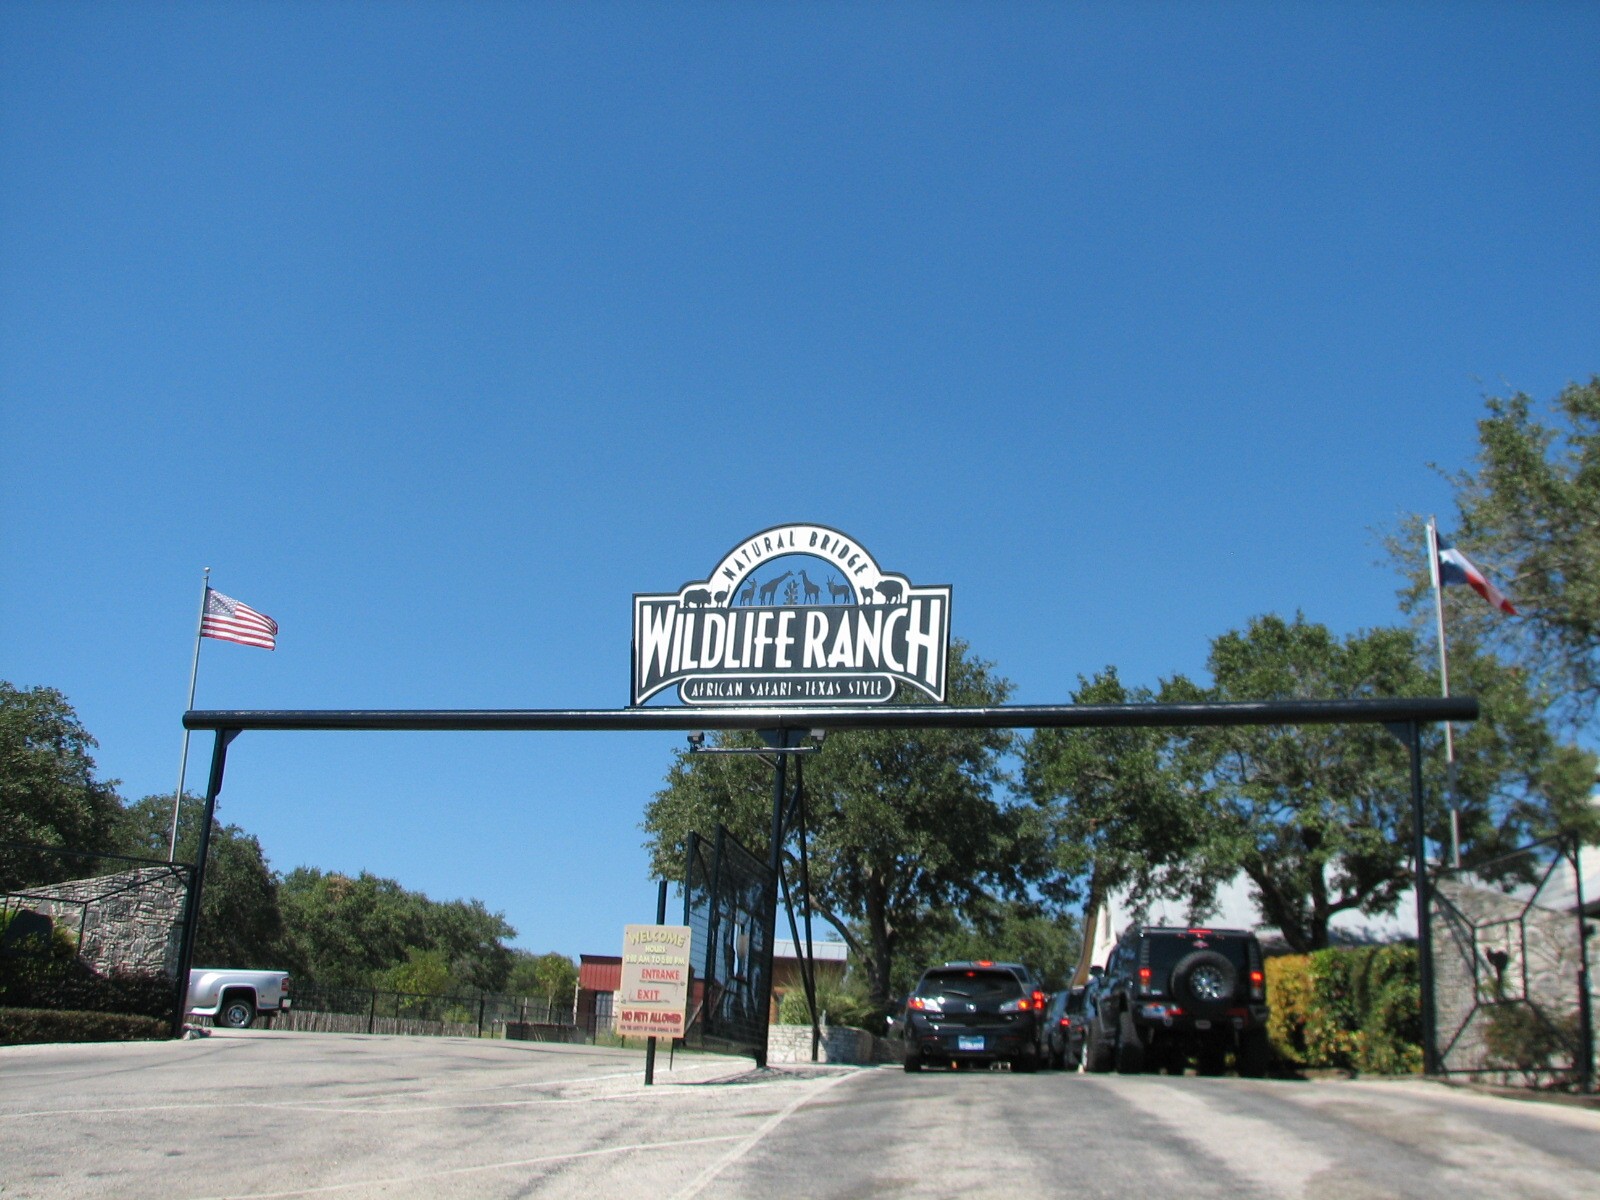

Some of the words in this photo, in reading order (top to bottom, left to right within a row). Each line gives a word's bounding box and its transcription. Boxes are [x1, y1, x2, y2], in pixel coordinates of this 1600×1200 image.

[722, 531, 795, 581] NATURAL
[809, 531, 868, 577] BRIDGE
[641, 604, 796, 688] WILDLIFE
[803, 598, 941, 688] RANCH
[691, 681, 743, 697] AFRICAN
[750, 681, 792, 697] SAFARI
[805, 681, 841, 697] TEXAS
[848, 680, 882, 695] STYLE
[629, 930, 686, 948] WELCOME
[638, 955, 650, 965] AM
[652, 955, 660, 965] TO
[641, 968, 680, 981] ENTRANCE
[637, 989, 660, 1000] EXIT
[621, 1010, 633, 1021] NO
[650, 1012, 682, 1025] ALLOWED
